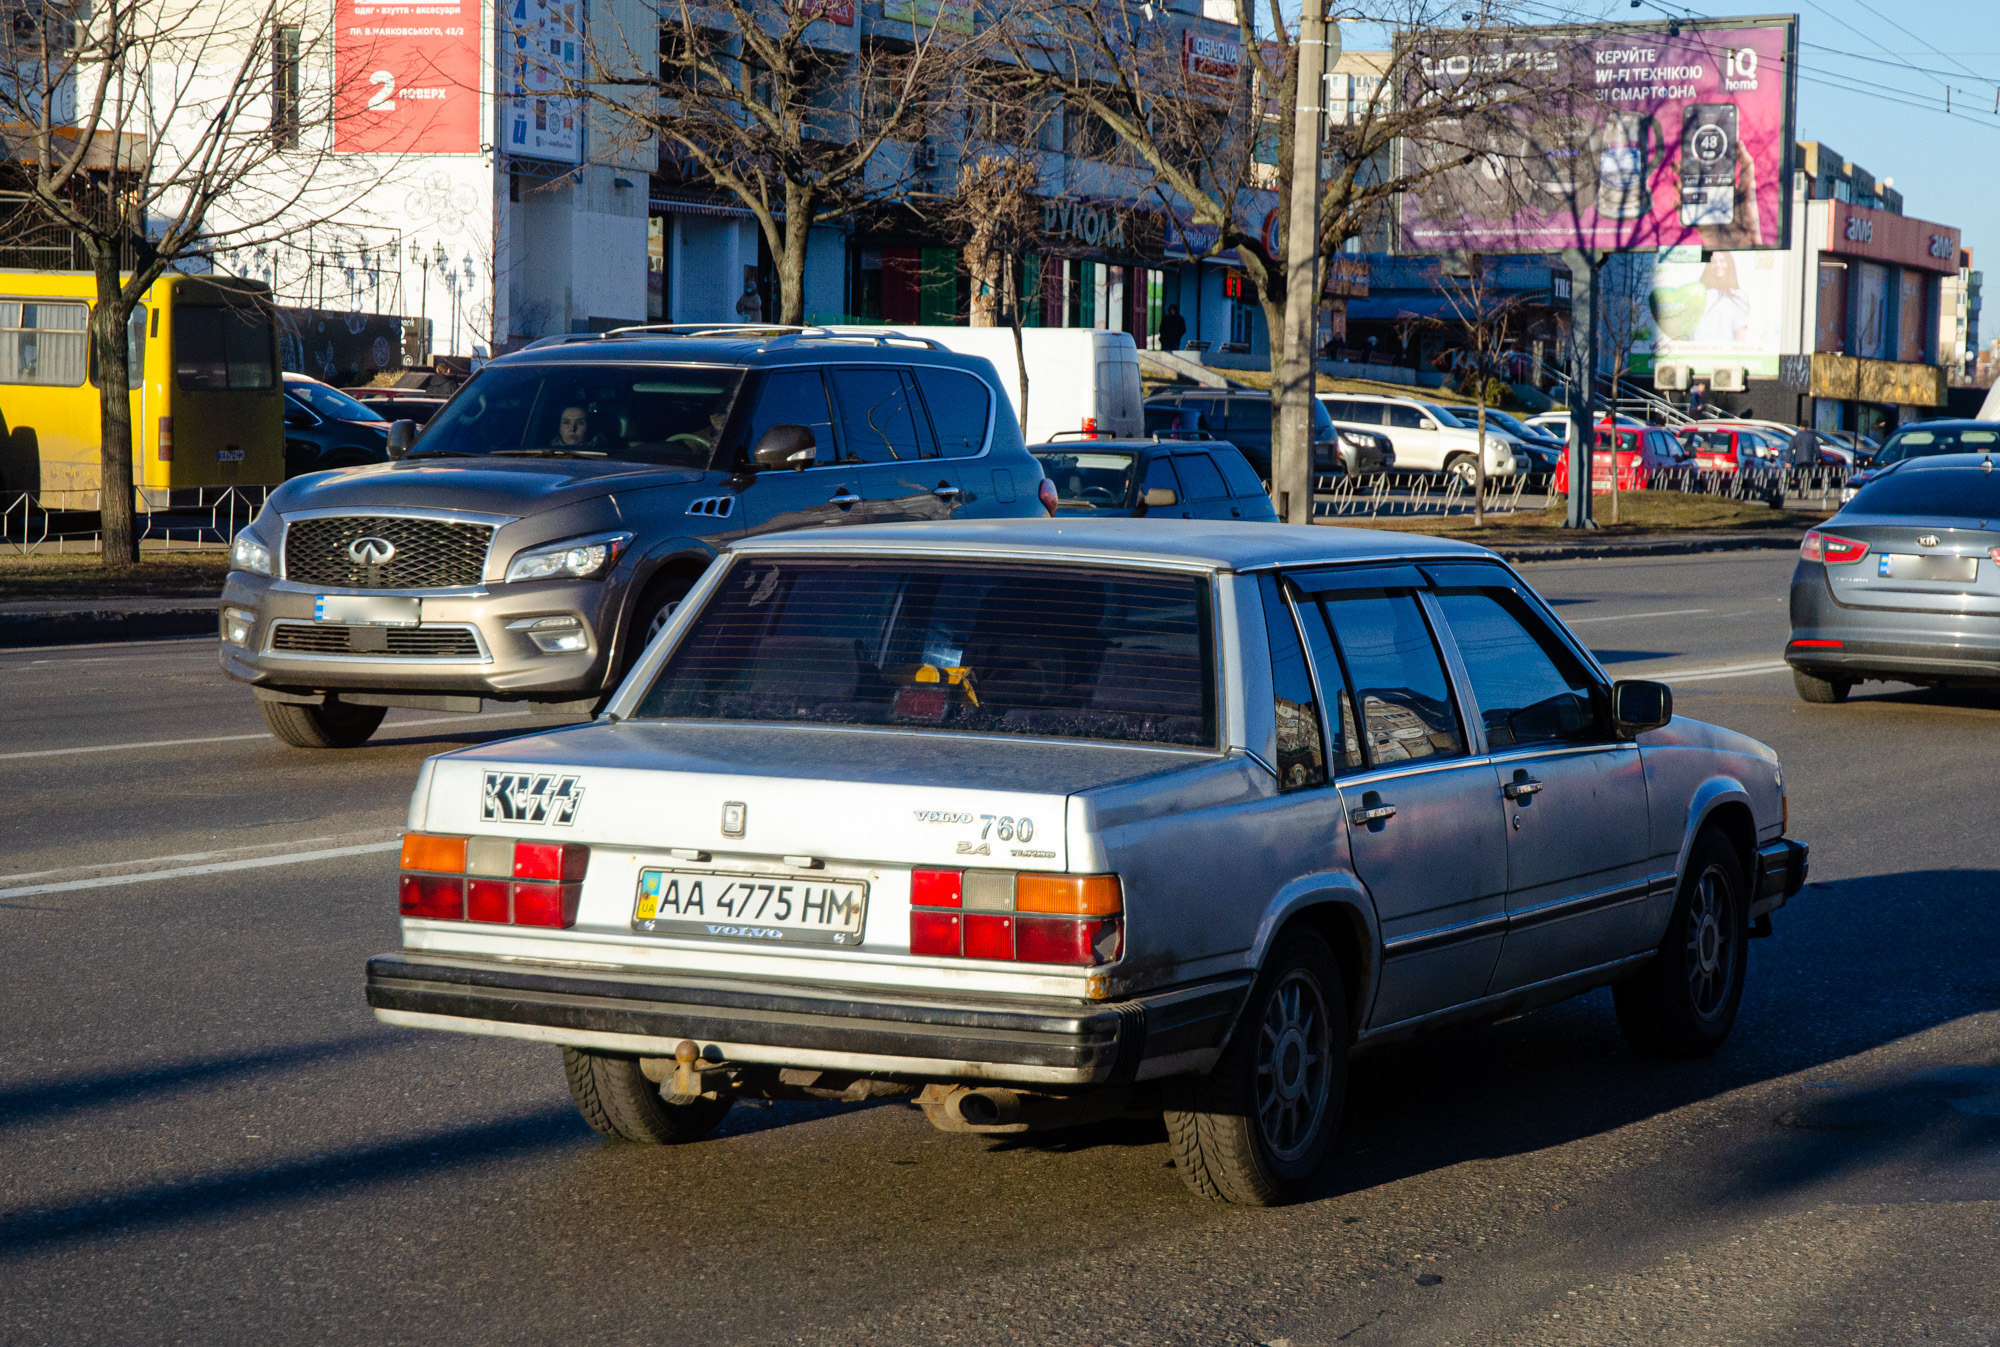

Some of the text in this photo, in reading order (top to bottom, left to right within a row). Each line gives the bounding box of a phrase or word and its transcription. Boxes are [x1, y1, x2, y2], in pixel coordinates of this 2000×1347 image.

[355, 7, 460, 15] одяг взуття аксесуари
[1196, 38, 1238, 63] OBNOVA
[1596, 47, 1655, 64] КЕРУЙТЕ
[1727, 48, 1758, 79] iQ
[1596, 65, 1702, 83] WI-FI ТЕХНІКОЮ
[368, 70, 446, 111] 2 ПОВЕРХ
[1612, 85, 1697, 100] СМАРТФОНА
[1725, 78, 1758, 91] home
[1701, 136, 1717, 149] 48
[1044, 201, 1125, 249] РУКОЛА
[1554, 277, 1570, 299] THE
[1918, 536, 1939, 547] KIA
[480, 770, 585, 827] KISS
[914, 810, 1034, 843] VOLVO 760
[641, 902, 655, 913] UA
[659, 879, 704, 916] AA
[716, 882, 793, 921] 4775
[705, 924, 783, 939] VOLVO
